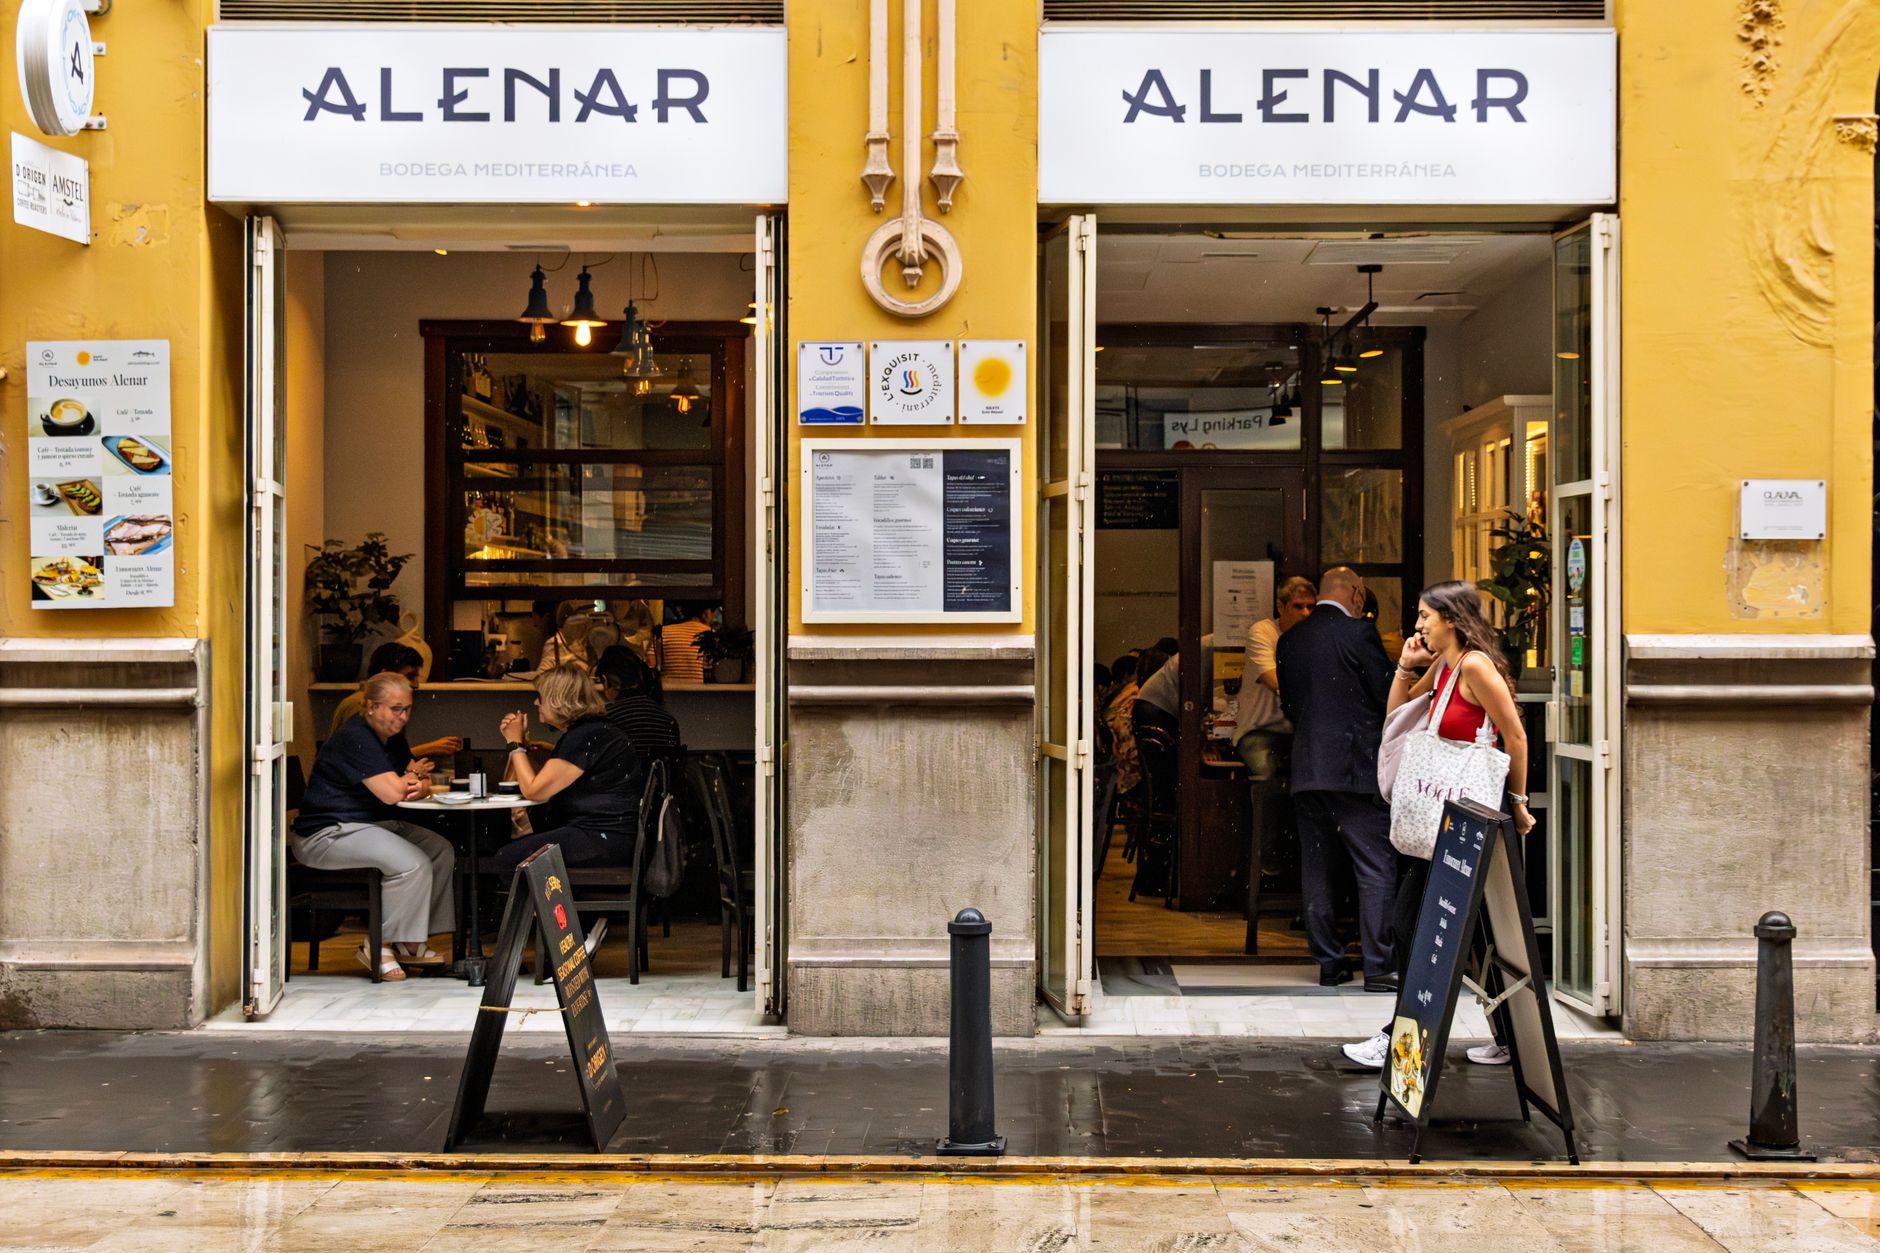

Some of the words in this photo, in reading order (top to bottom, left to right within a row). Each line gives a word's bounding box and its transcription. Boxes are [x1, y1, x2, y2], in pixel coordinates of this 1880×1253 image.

[303, 67, 710, 123] ALENAR
[1122, 67, 1529, 123] ALENAR
[380, 163, 467, 178] BODEGA
[474, 161, 637, 179] MEDITERRÁNEA
[1199, 164, 1287, 178] BODEGA
[1293, 162, 1457, 178] MEDITERRÁNEA
[52, 174, 84, 202] AMSTEL
[49, 375, 108, 390] Desayunos
[110, 374, 149, 387] Alenar
[881, 353, 920, 402] L'EXQUISIT
